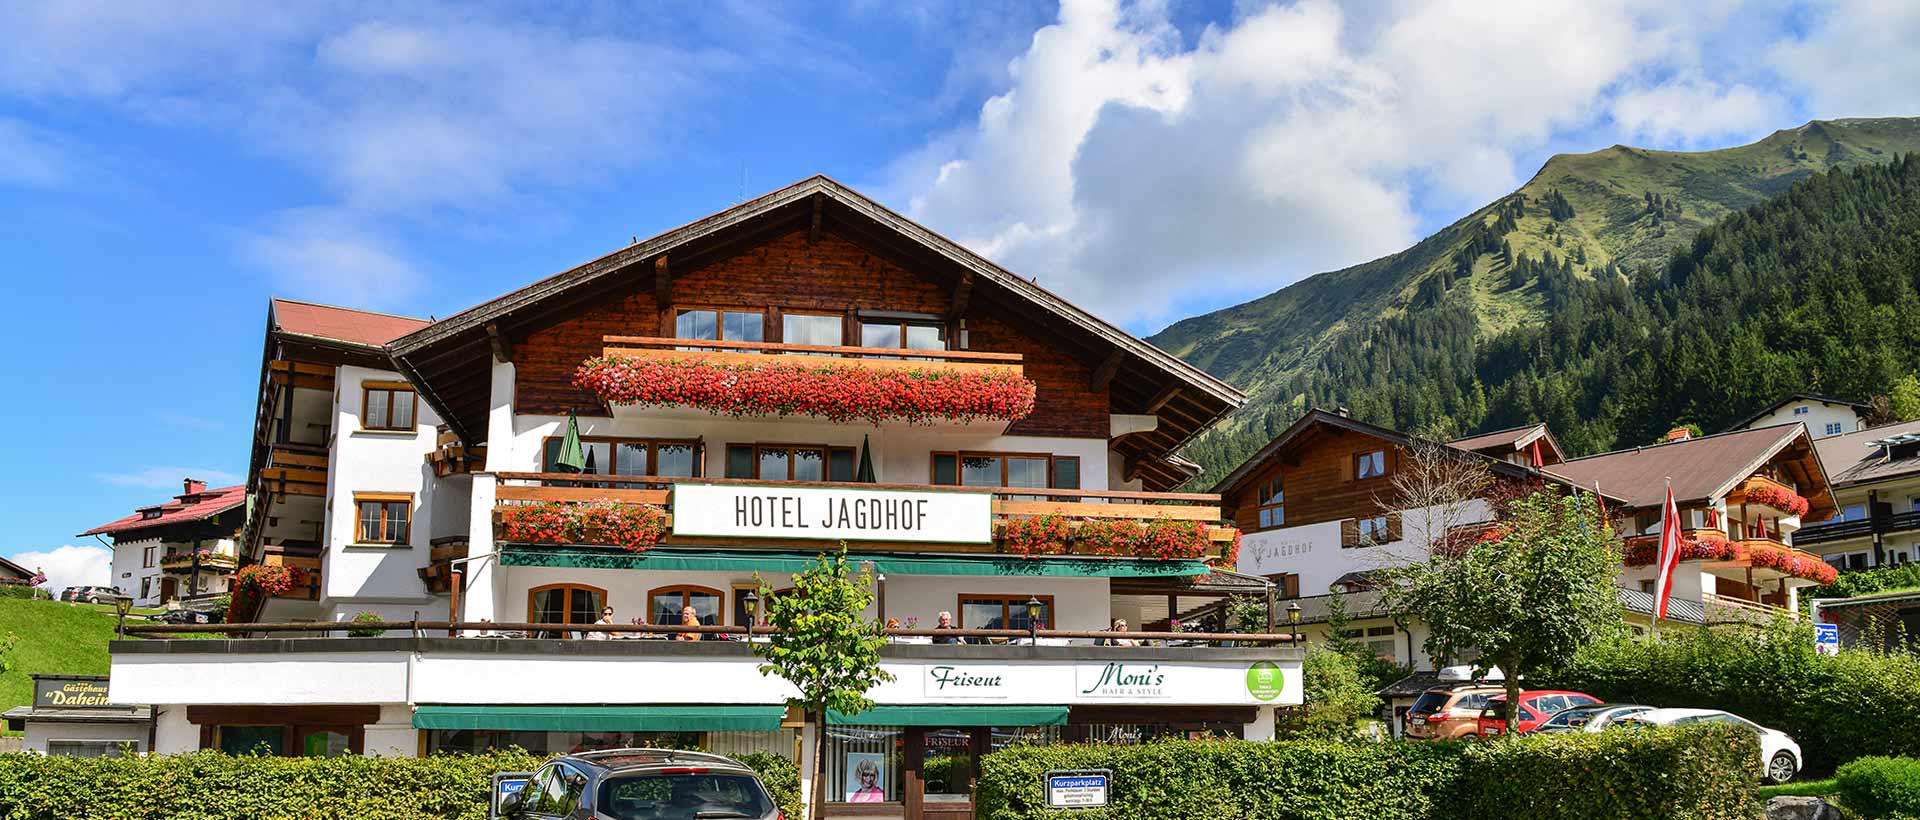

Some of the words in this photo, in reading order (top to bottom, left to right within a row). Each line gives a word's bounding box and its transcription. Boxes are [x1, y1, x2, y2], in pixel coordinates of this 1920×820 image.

[735, 495, 809, 528] HOTEL
[821, 497, 929, 531] JAGDHOF
[1266, 542, 1312, 558] JAGDHOF
[930, 666, 1002, 690] Friseur
[1082, 662, 1164, 694] Moni's
[63, 683, 108, 693] Gästehaus
[924, 736, 969, 747] FRISEUR
[1054, 779, 1102, 788] Kurzparkplatz
